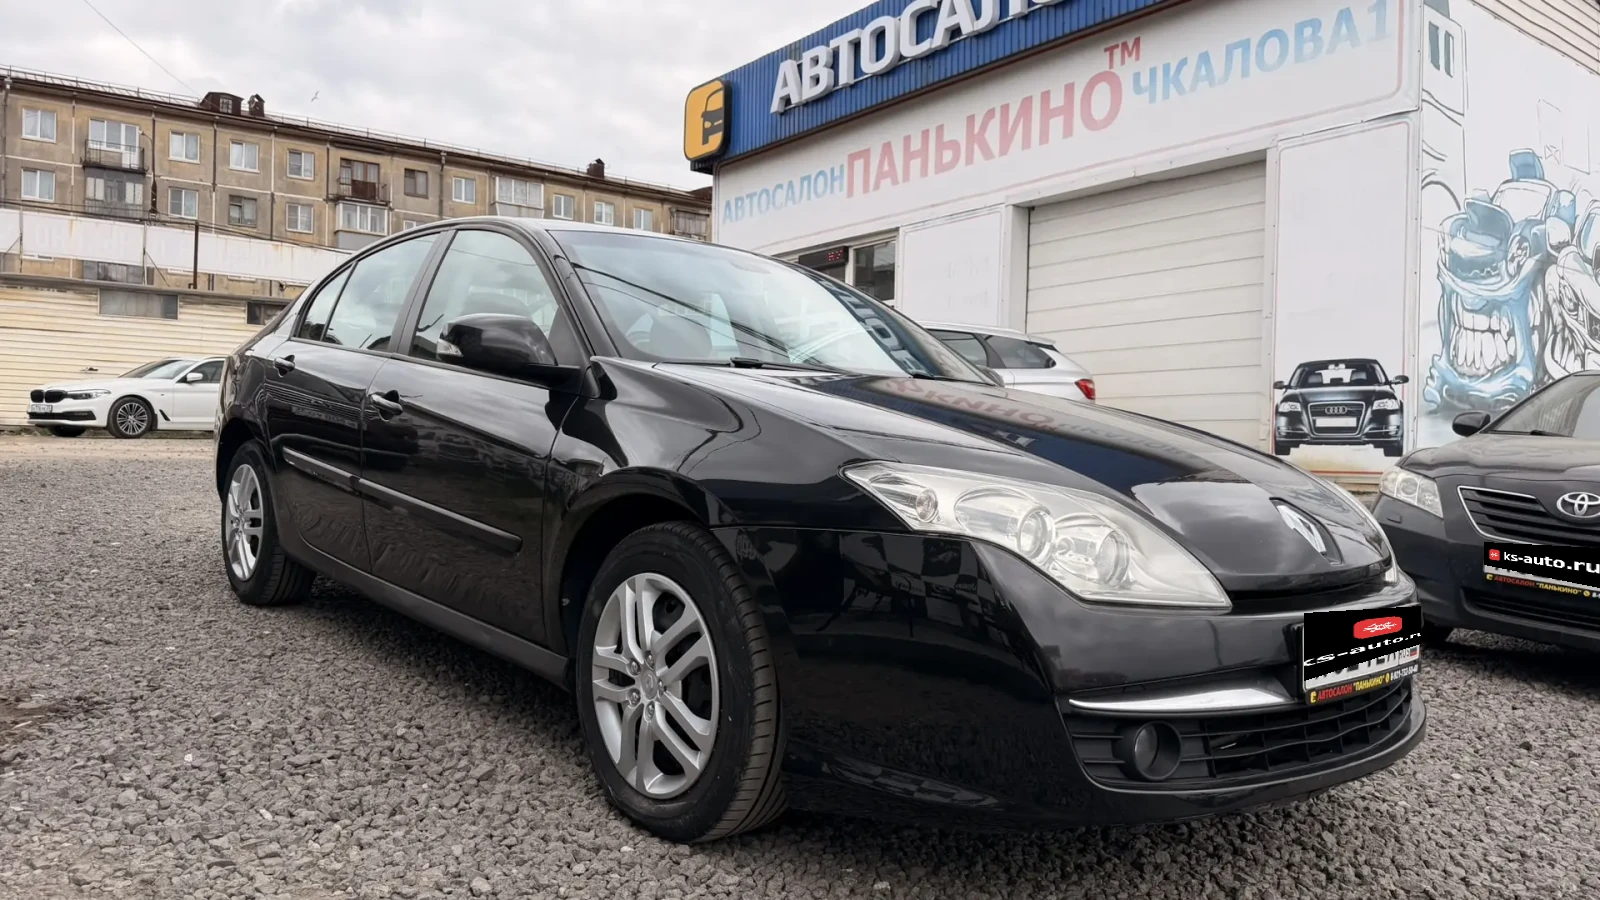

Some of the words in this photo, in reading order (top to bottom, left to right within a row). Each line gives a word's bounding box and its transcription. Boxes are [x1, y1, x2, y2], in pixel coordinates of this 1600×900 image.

[770, 0, 1067, 115] АВТОСА
[722, 164, 845, 225] АВТОСАЛОН
[846, 70, 1123, 199] ПАНЬКИНО
[1494, 575, 1535, 587] АВТОСАЛОН
[1317, 683, 1353, 701] АВТОСАЛОН
